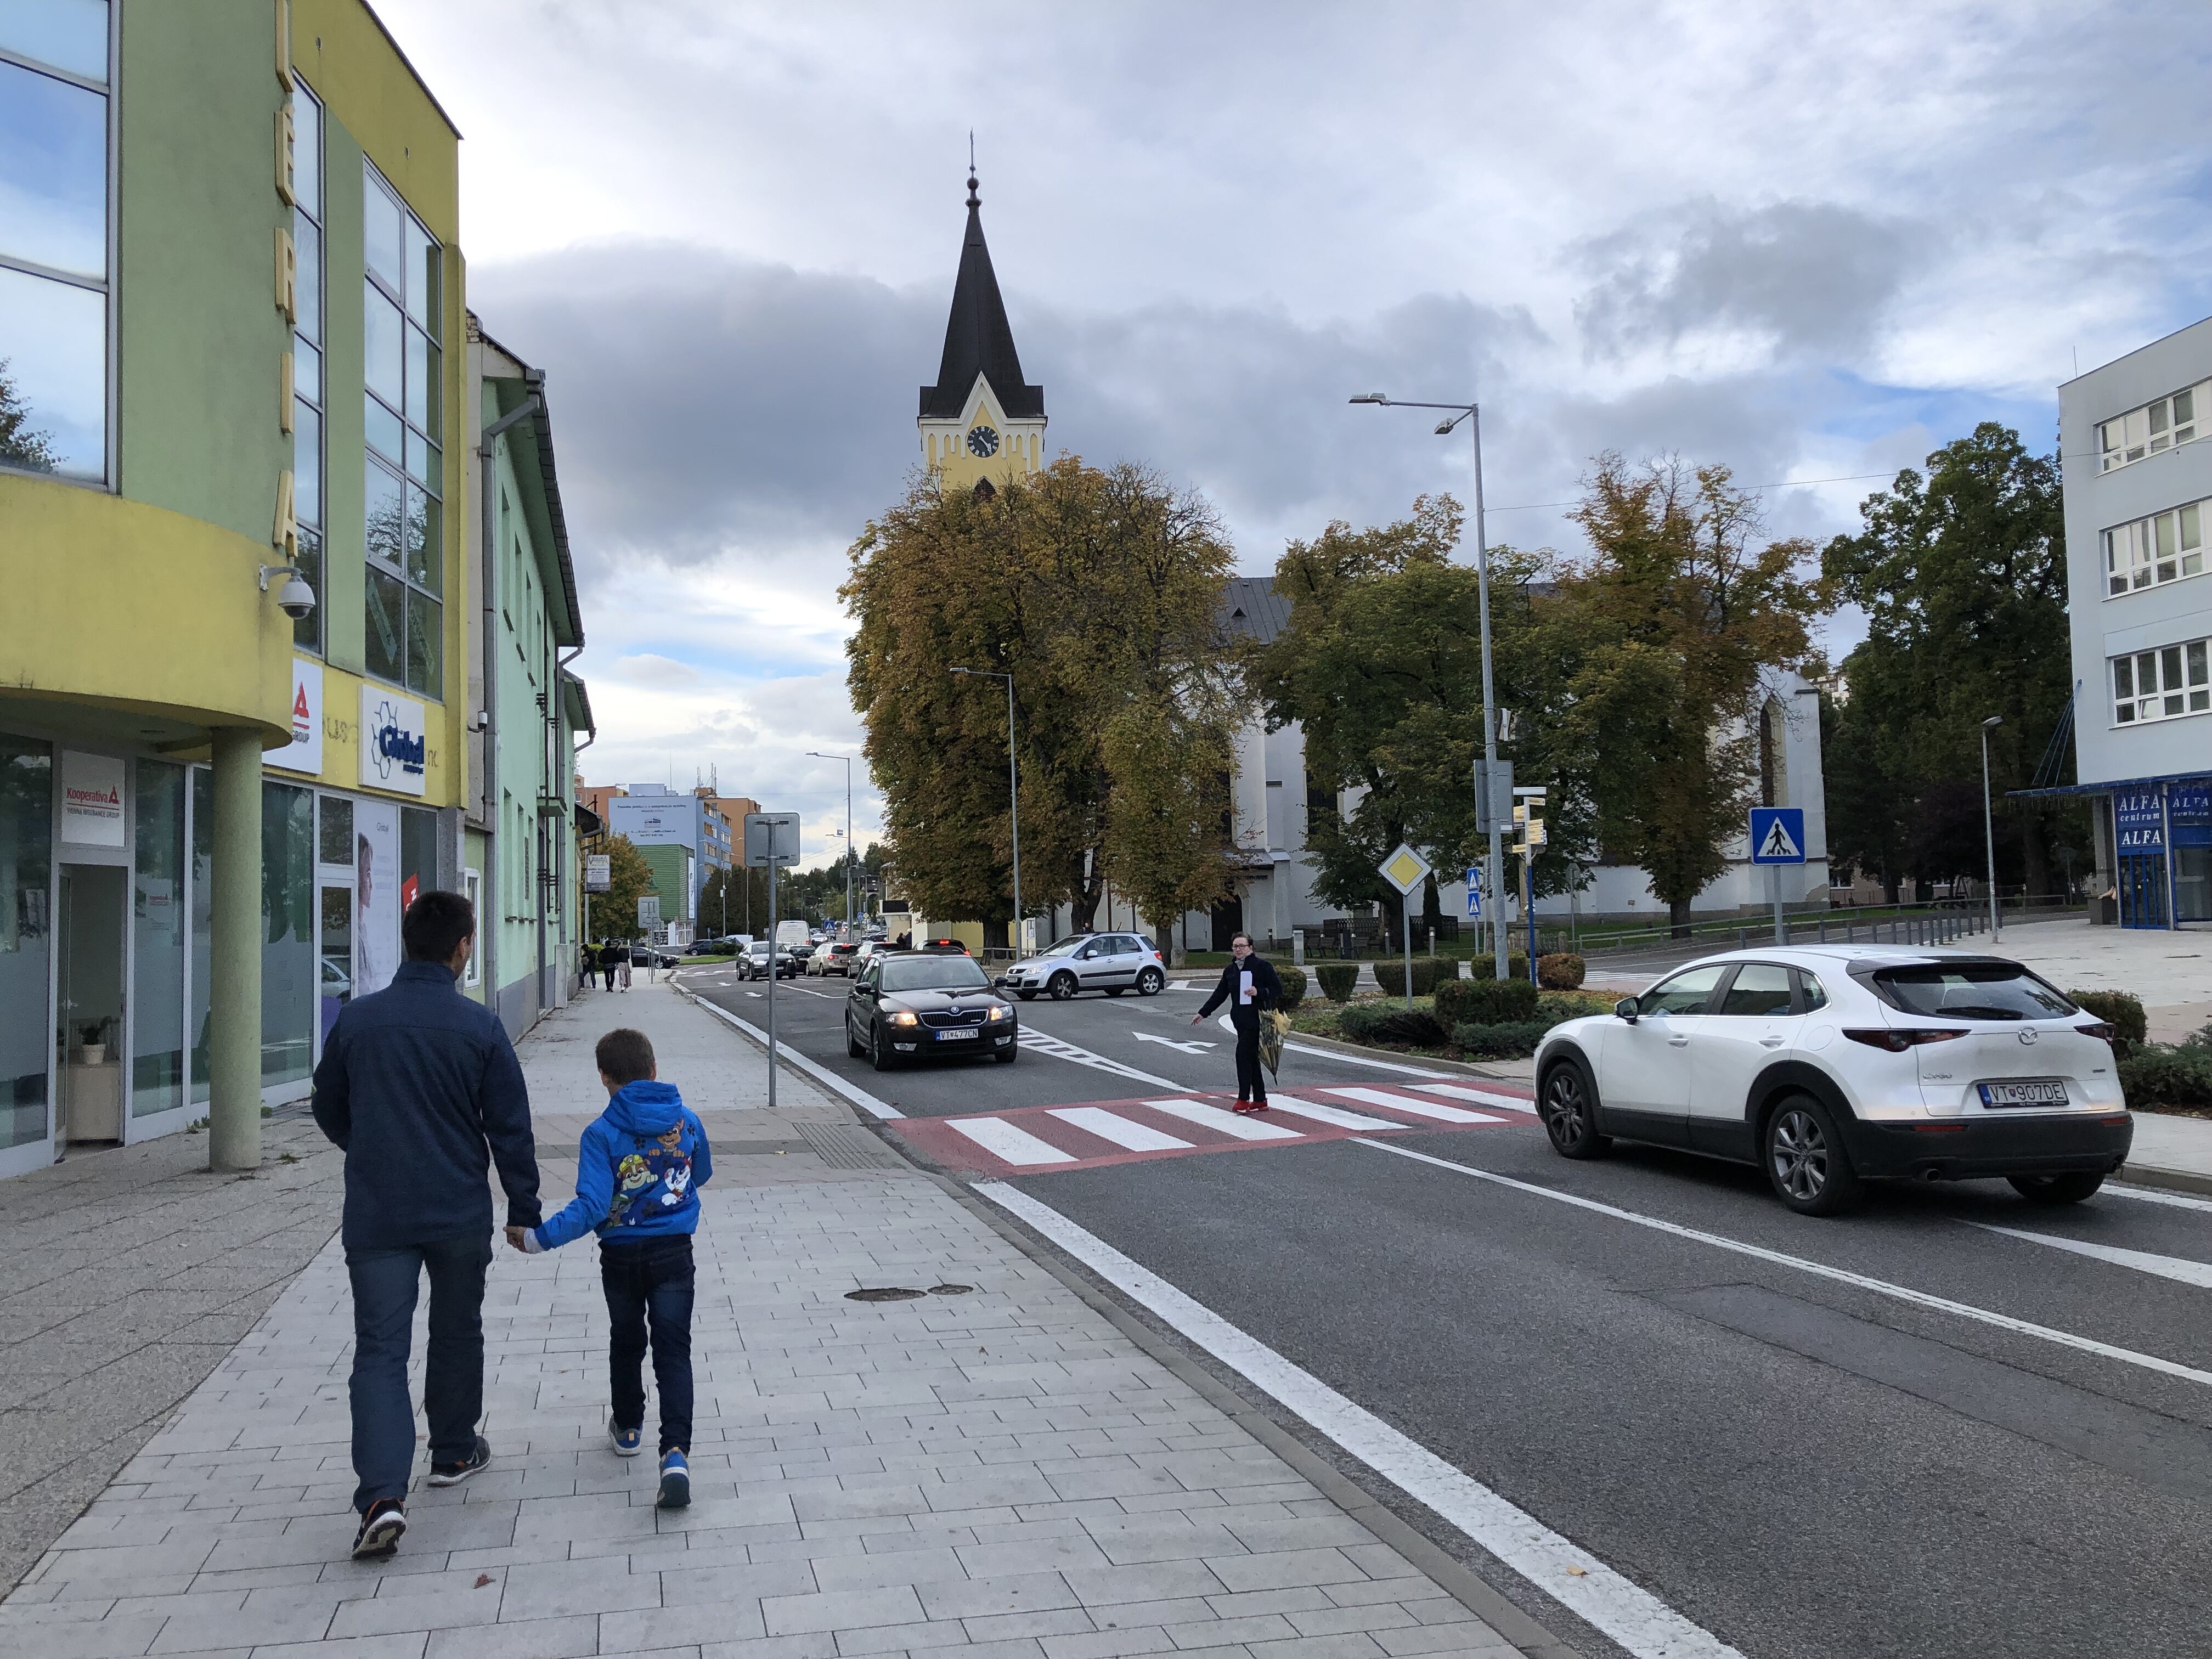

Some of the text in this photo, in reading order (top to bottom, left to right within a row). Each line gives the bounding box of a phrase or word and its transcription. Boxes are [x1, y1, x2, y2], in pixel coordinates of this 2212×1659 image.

[66, 787, 108, 803] Kooperativa
[2119, 794, 2160, 811] ALFA
[2172, 797, 2209, 808] ALFA
[66, 807, 82, 815] VIENNA
[83, 809, 105, 818] INSURANCE
[2120, 812, 2159, 822] centrum
[2121, 830, 2161, 845] ALFA
[2016, 1084, 2064, 1101] 907DE
